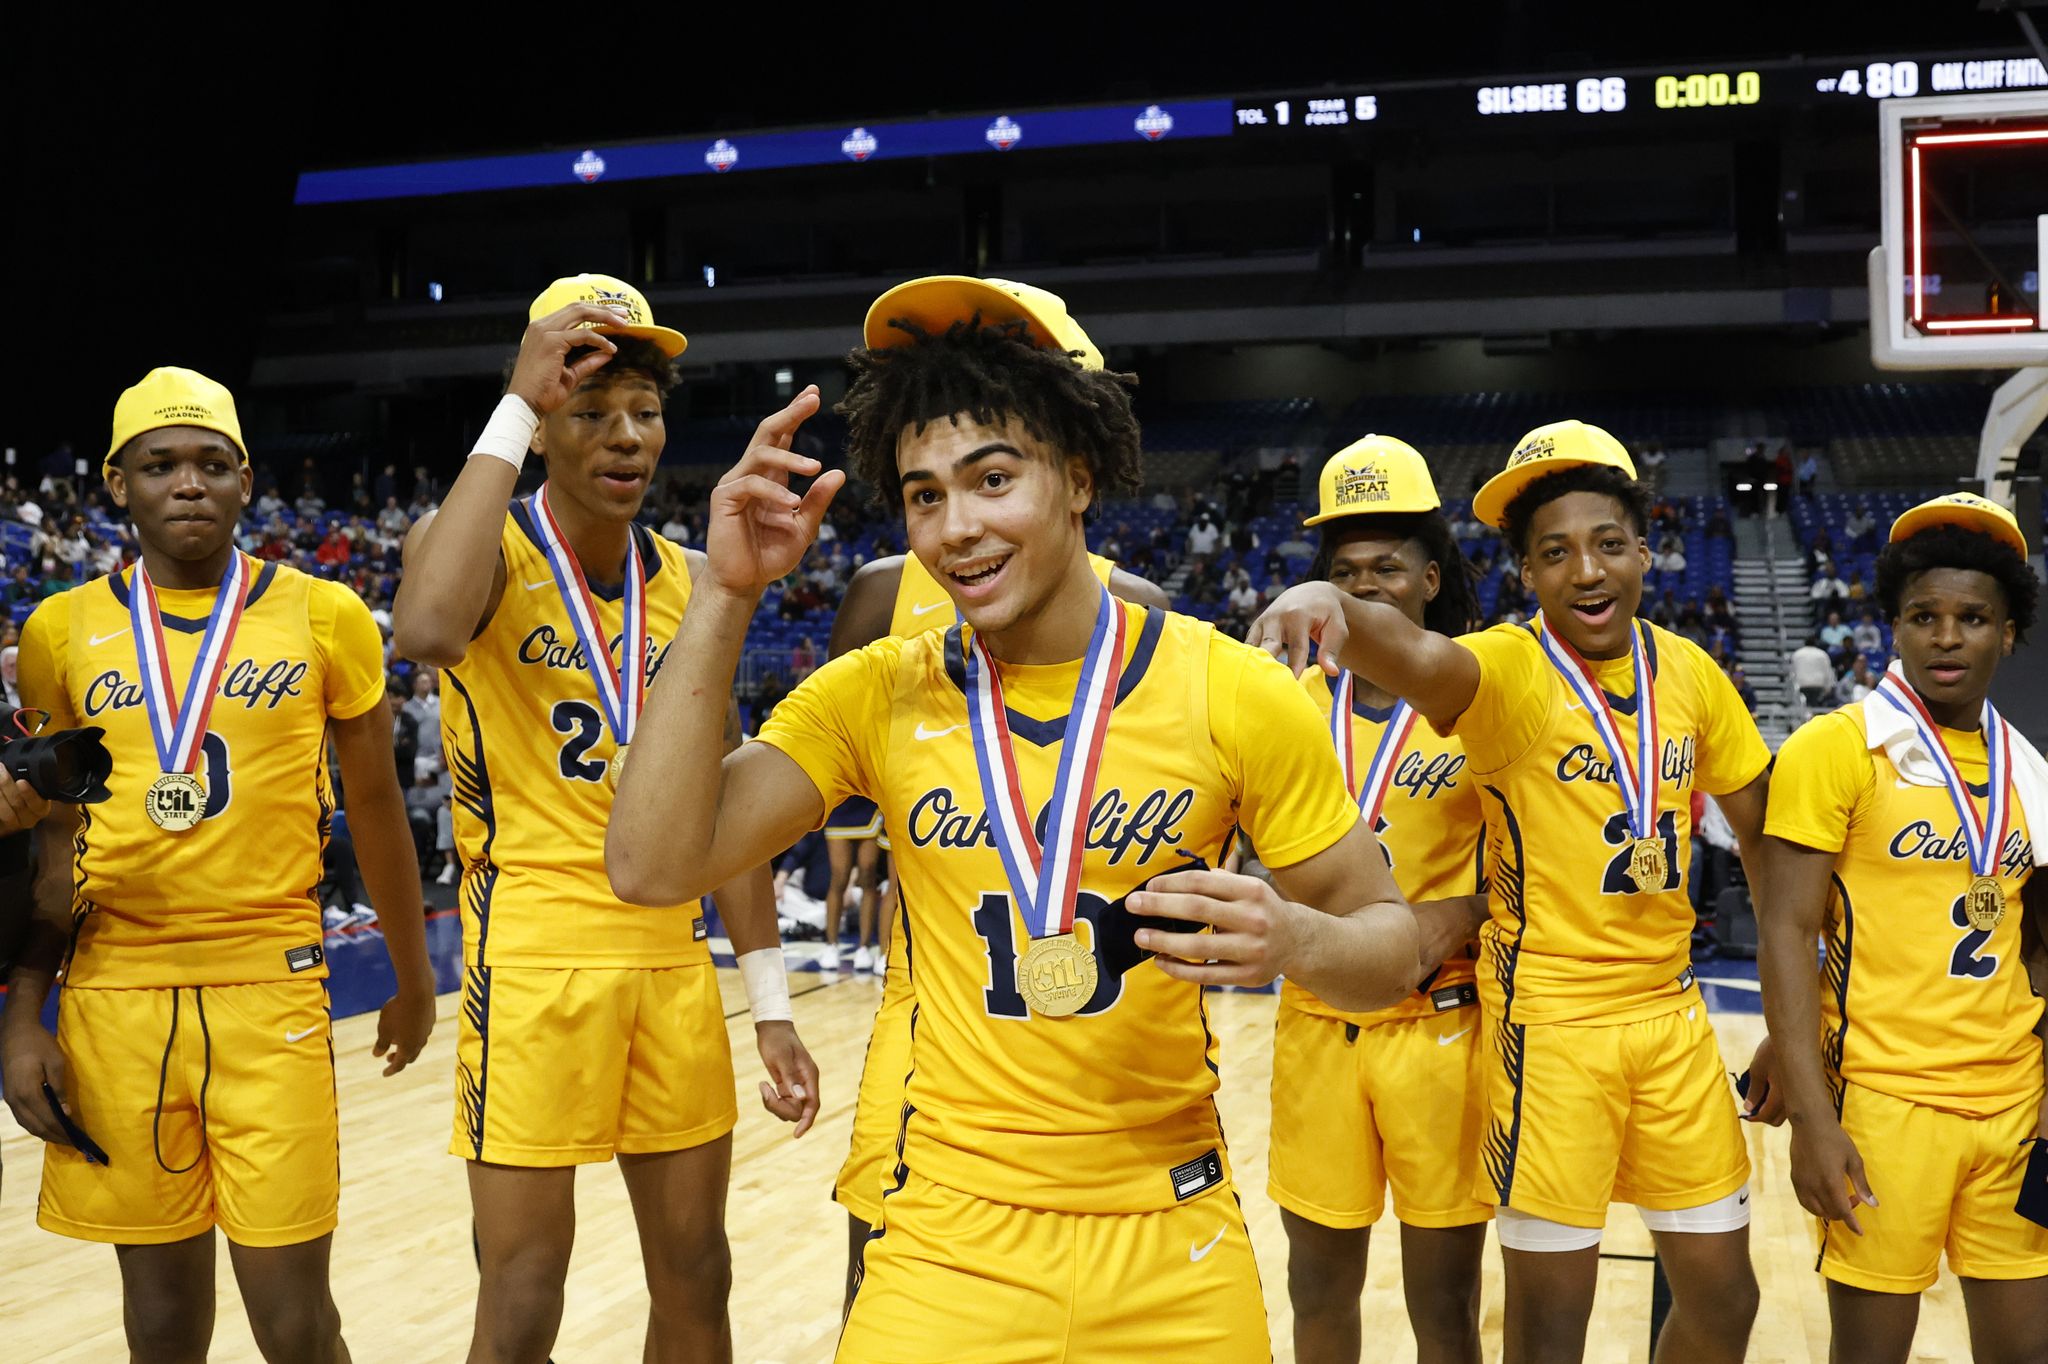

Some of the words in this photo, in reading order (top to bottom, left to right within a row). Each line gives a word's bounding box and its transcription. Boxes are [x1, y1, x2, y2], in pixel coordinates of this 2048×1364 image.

[1576, 76, 1626, 113] 66
[1655, 71, 1760, 108] 0:00.0
[1838, 69, 1862, 95] 4
[1866, 61, 1919, 98] 80
[1236, 108, 1268, 125] TOL
[1274, 101, 1290, 125] 1
[1307, 98, 1346, 113] TEAM
[1355, 95, 1377, 120] 5
[1477, 83, 1567, 115] SILSBEE
[1305, 111, 1348, 126] FOULS
[164, 412, 204, 420] ACADEMY
[1335, 490, 1391, 507] CHAMPIONS
[518, 625, 589, 671] Oak
[84, 670, 145, 717] Oa
[216, 658, 308, 709] liff
[1393, 750, 1467, 800] liff
[1661, 735, 1696, 791] liff
[1601, 808, 1683, 896] 21
[1889, 820, 1968, 862] Oak
[1947, 893, 2000, 981] 2
[314, 949, 321, 960] S
[1463, 989, 1471, 999] S
[1208, 1161, 1217, 1176] S
